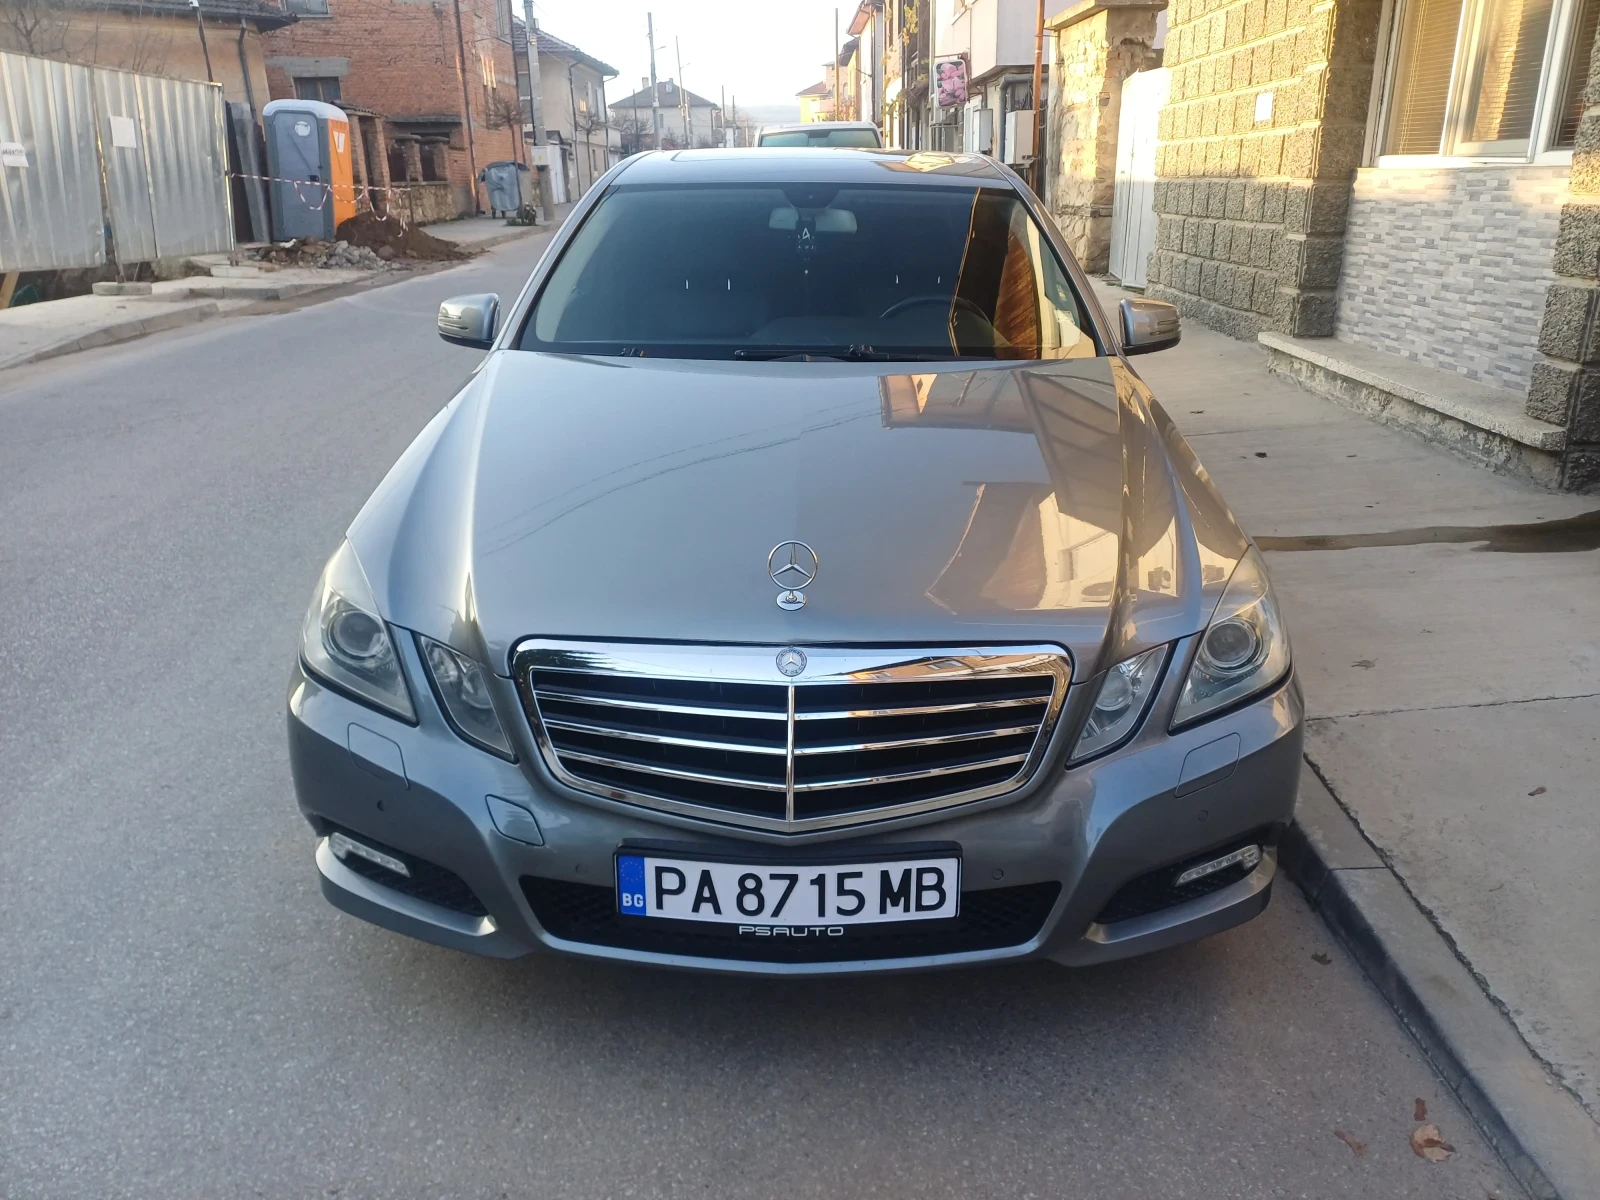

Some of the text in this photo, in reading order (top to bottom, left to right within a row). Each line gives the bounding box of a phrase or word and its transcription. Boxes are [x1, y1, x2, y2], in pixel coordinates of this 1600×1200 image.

[654, 865, 947, 918] PA 8715 MB
[622, 892, 644, 908] BG
[738, 925, 844, 937] PSAUTO
